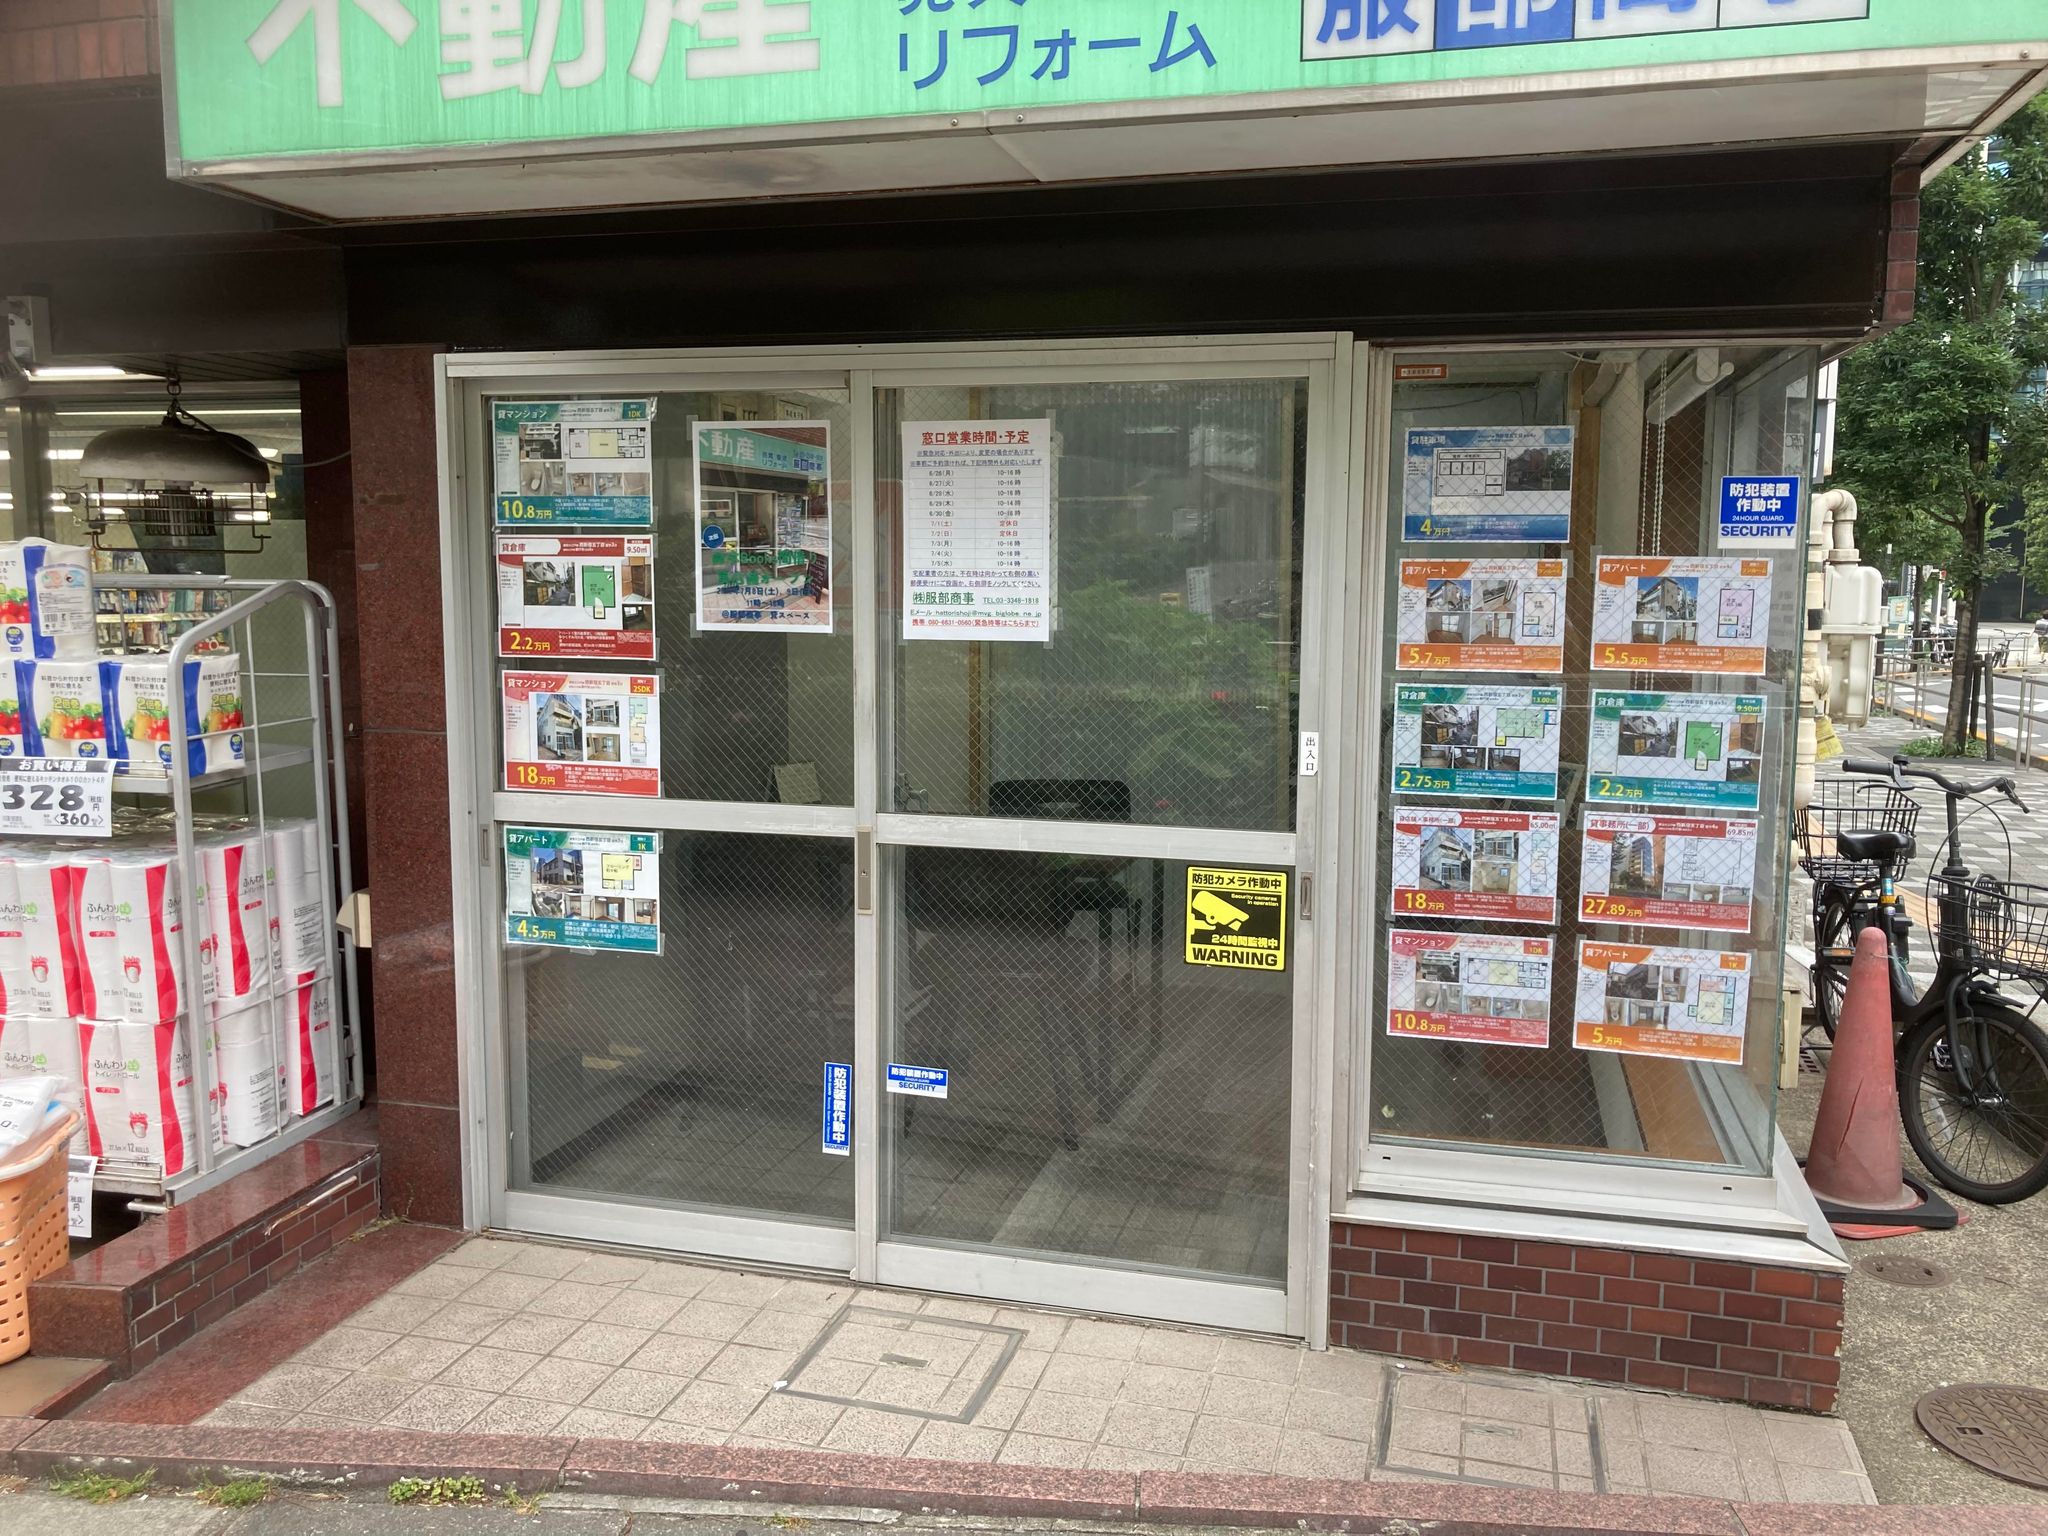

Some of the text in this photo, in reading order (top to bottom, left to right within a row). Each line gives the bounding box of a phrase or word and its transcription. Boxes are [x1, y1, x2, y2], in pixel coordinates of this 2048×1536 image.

[899, 10, 1216, 89] リフォーム
[498, 410, 547, 419] 貸マンション
[922, 431, 1029, 445] 窓口営業時間・予定
[1730, 483, 1790, 497] 防犯装置
[502, 500, 552, 519] 10.8万円
[1736, 498, 1781, 512] 作動中
[1420, 519, 1450, 537] 4万円
[1721, 526, 1794, 536] SECURITY
[502, 543, 526, 552] 貸倉庫
[1404, 566, 1447, 575] 貸アパート
[1602, 563, 1646, 573] 貸アパート
[510, 632, 550, 651] 2.2万円
[1409, 647, 1450, 665] 5.7万円
[1604, 647, 1648, 666] 5.5万円
[507, 678, 556, 688] 貸マンション
[1400, 691, 1426, 700] 貸倉庫
[1598, 697, 1625, 707] 貸倉庫
[1306, 737, 1315, 771] 出入口
[19, 760, 87, 771] お買い得品
[516, 766, 555, 785] 18万円
[1400, 771, 1450, 789] 2.75万円
[1600, 779, 1642, 797] 2.2万円
[2, 784, 85, 811] 328
[92, 803, 99, 811] 円
[60, 813, 89, 825] 360
[509, 834, 548, 843] 貸アパート
[1192, 873, 1281, 889] 防犯カメラ作動中
[88, 903, 119, 913] ふんわり
[1405, 893, 1444, 911] 18万円
[1585, 899, 1642, 918] 27.89万円
[517, 920, 556, 940] 4.5万円
[1212, 934, 1278, 948] 24時間監視中
[1395, 936, 1445, 947] 貸マンション
[1193, 947, 1277, 966] WARNING
[1585, 948, 1628, 959] 貸アパート
[1394, 1013, 1445, 1033] 10.8万円
[1592, 1028, 1622, 1046] 5万円
[5, 1052, 35, 1062] ふんわり
[94, 1058, 127, 1070] ふんわり
[95, 1070, 140, 1080] トイレットロール
[891, 1067, 944, 1081] 防犯装置作動中
[899, 1082, 936, 1092] SECURITY
[833, 1067, 847, 1144] 防犯装置作動中
[128, 1143, 134, 1152] 12
[824, 1144, 849, 1152] SECURITY
[73, 1203, 80, 1211] 円
